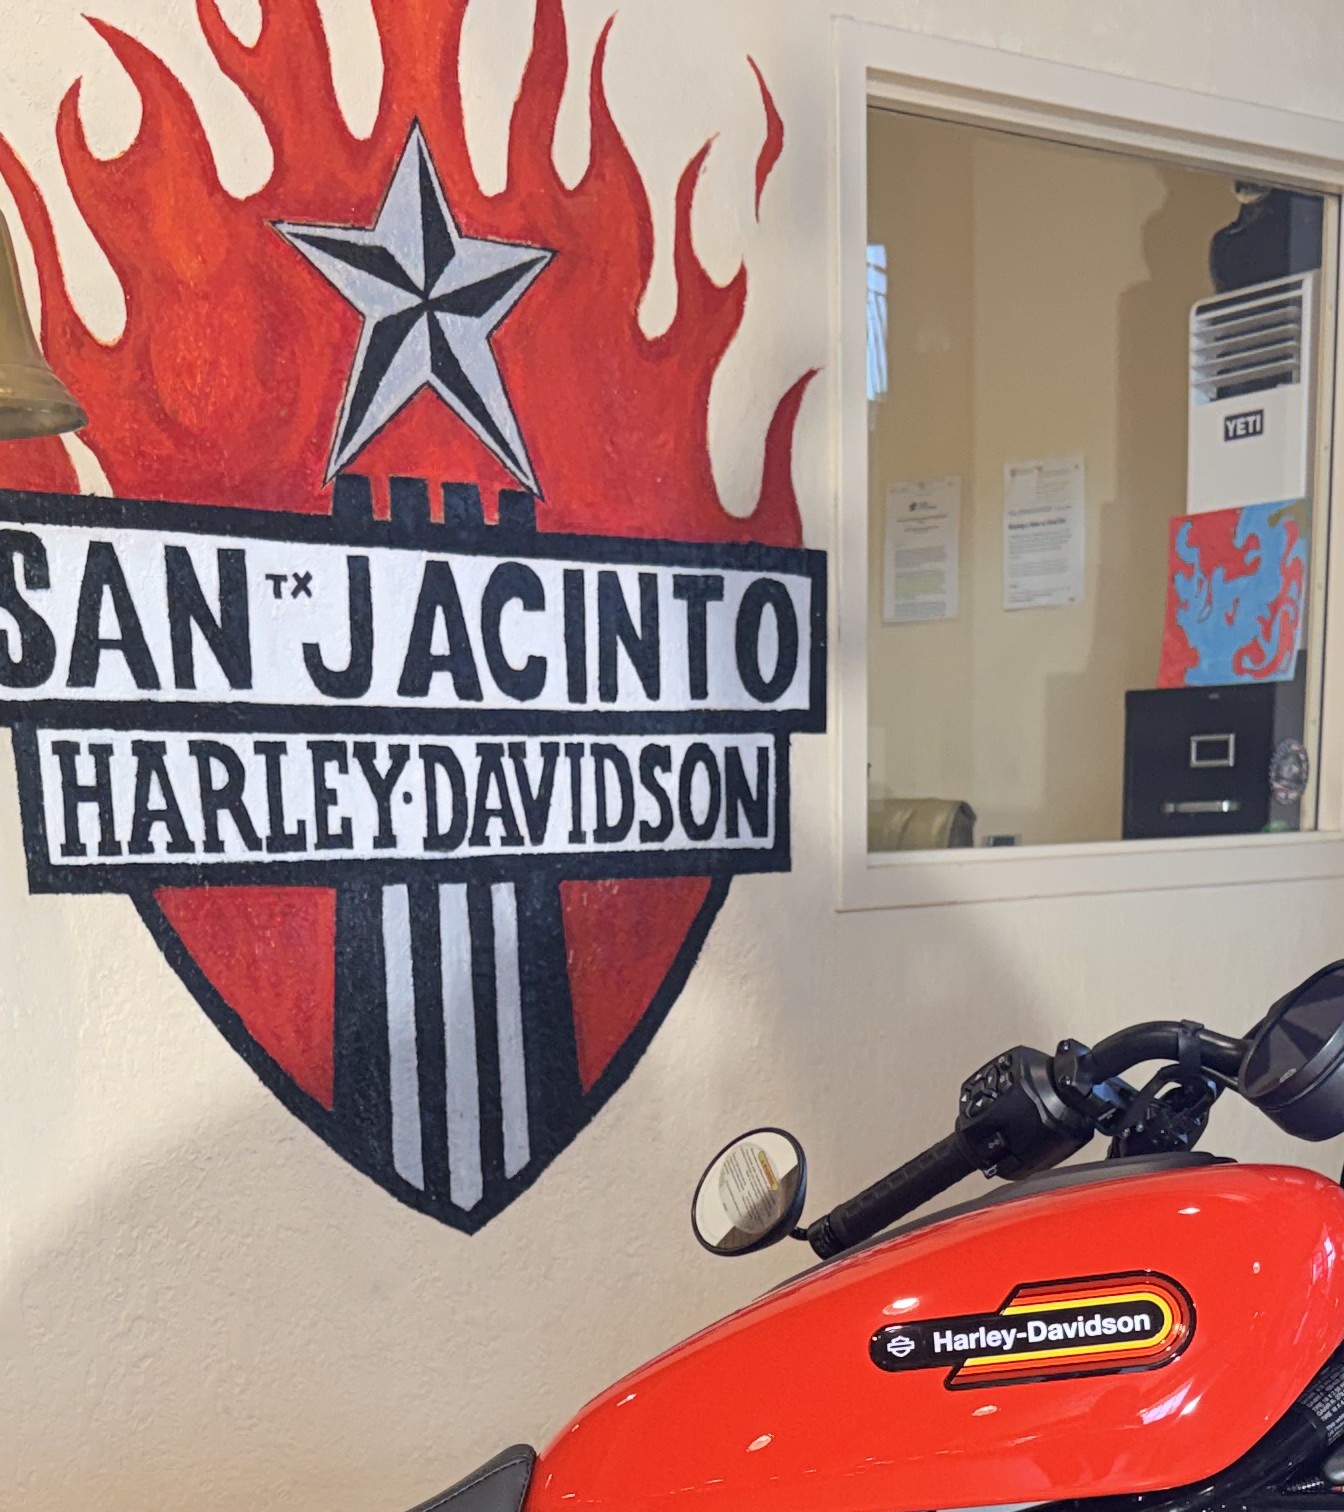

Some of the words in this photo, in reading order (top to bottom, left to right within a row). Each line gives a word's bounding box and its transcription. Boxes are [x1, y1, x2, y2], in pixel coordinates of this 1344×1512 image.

[1226, 413, 1261, 438] YETI
[302, 552, 800, 704] JACINTO
[933, 1311, 1151, 1354] Harley-Davidson
